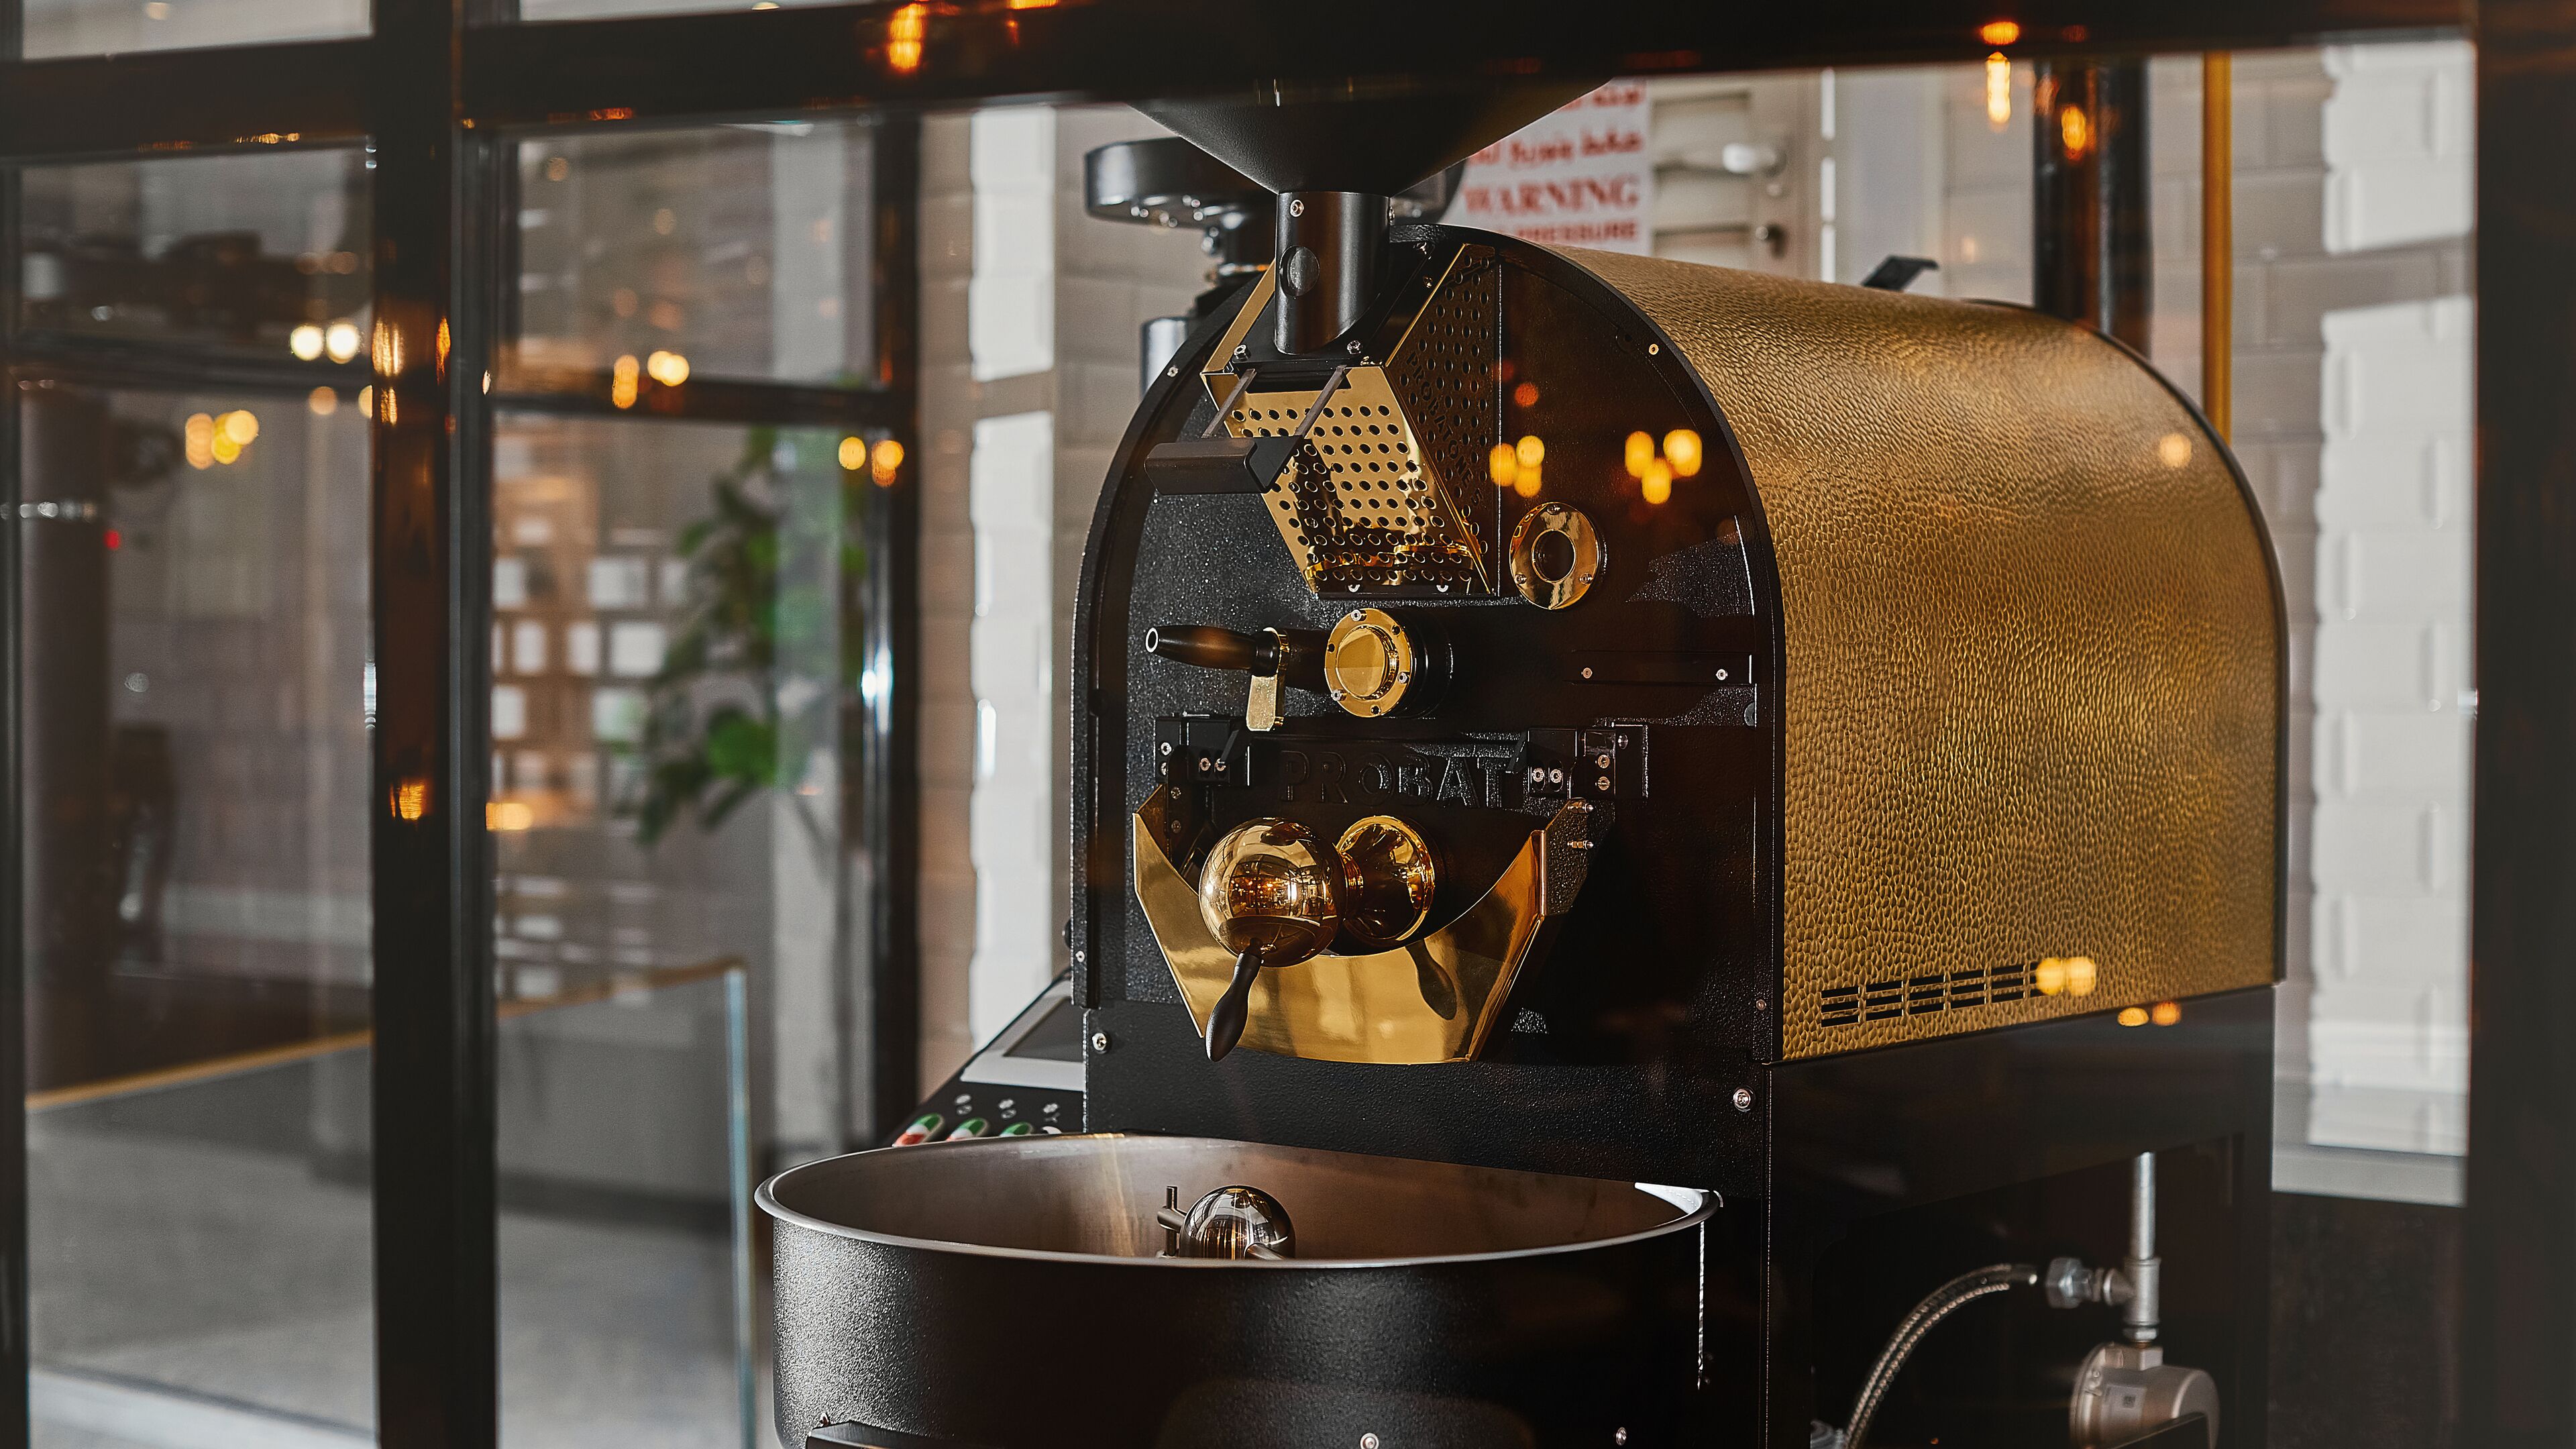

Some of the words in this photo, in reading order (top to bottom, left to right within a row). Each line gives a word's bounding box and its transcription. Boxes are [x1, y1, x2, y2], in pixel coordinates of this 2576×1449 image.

[1464, 174, 1640, 215] WARNING
[1406, 351, 1472, 488] PROBATONE
[1279, 750, 1511, 808] PROBAT
